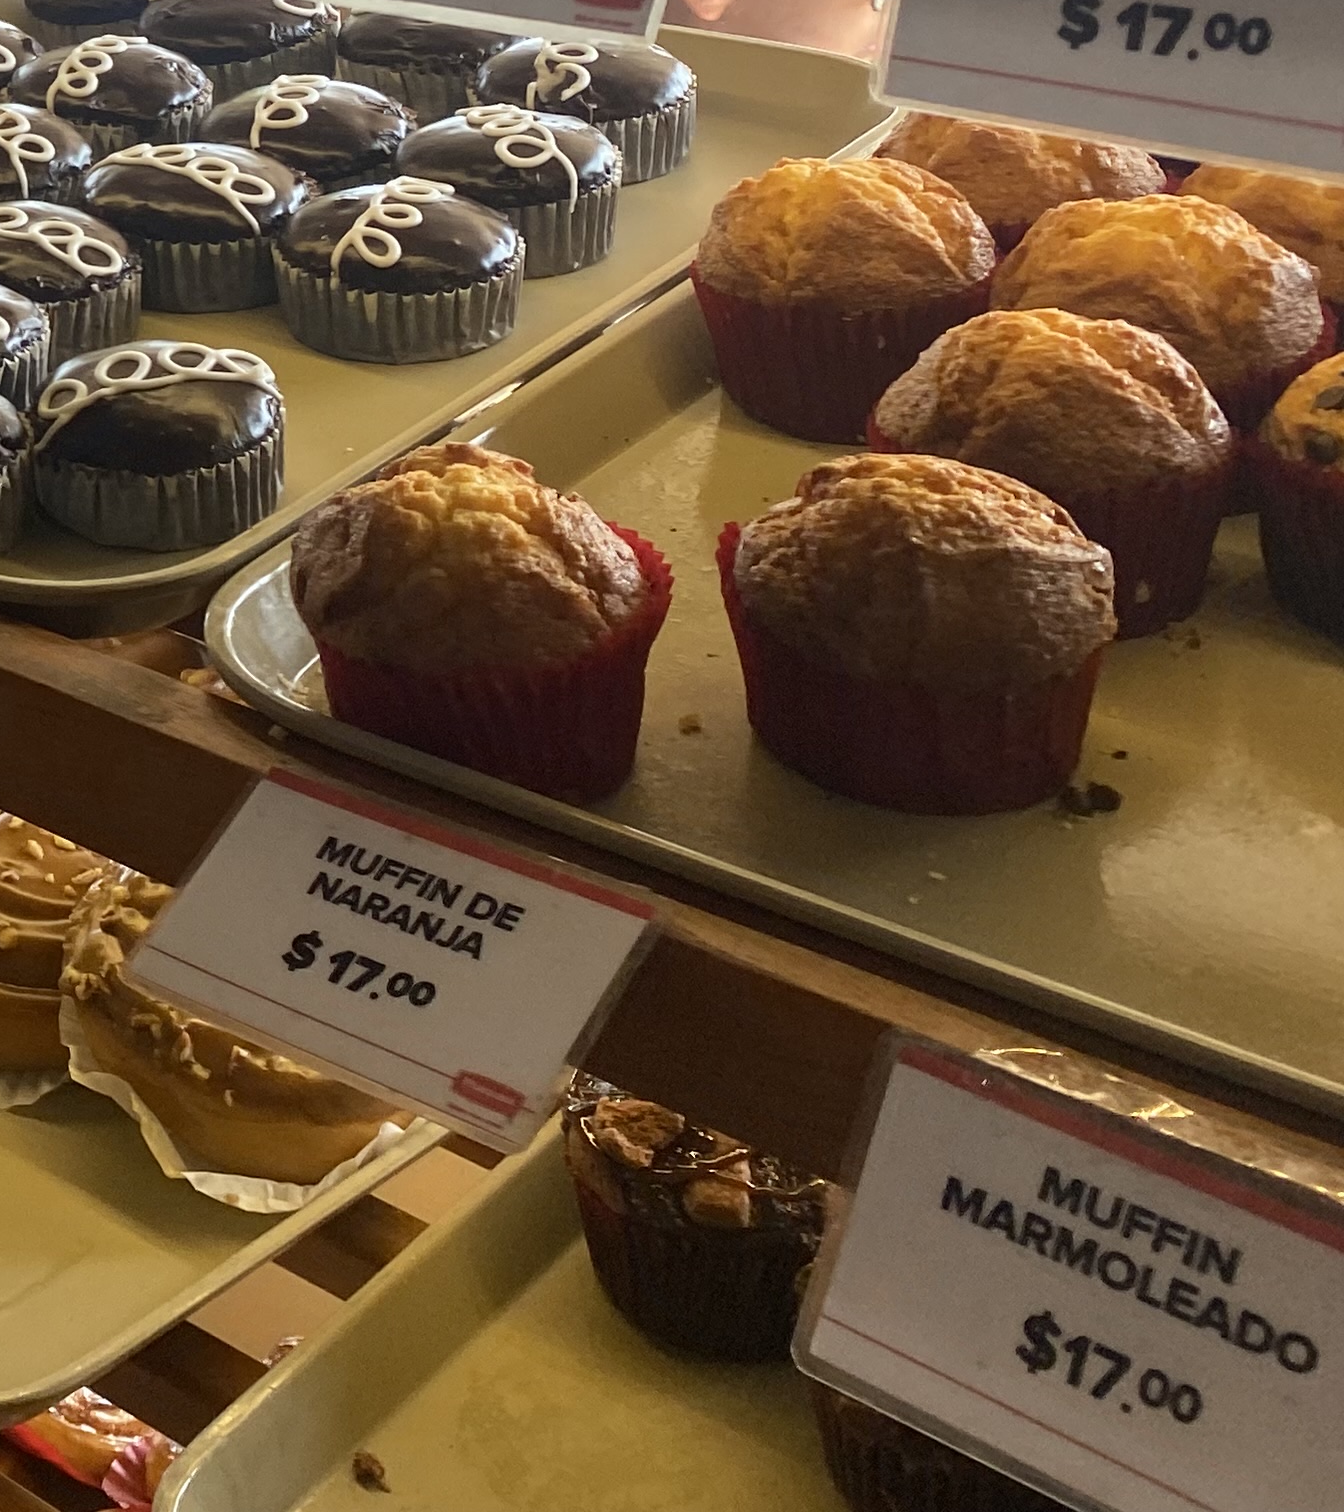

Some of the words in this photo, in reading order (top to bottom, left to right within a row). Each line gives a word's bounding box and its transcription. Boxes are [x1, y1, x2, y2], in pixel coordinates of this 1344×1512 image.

[306, 870, 485, 962] NARANJA
[315, 834, 465, 909] MUFFIN
[464, 890, 527, 933] DE
[939, 1175, 1320, 1375] MARMOLEADO
[1037, 1165, 1244, 1285] MUFFIN
